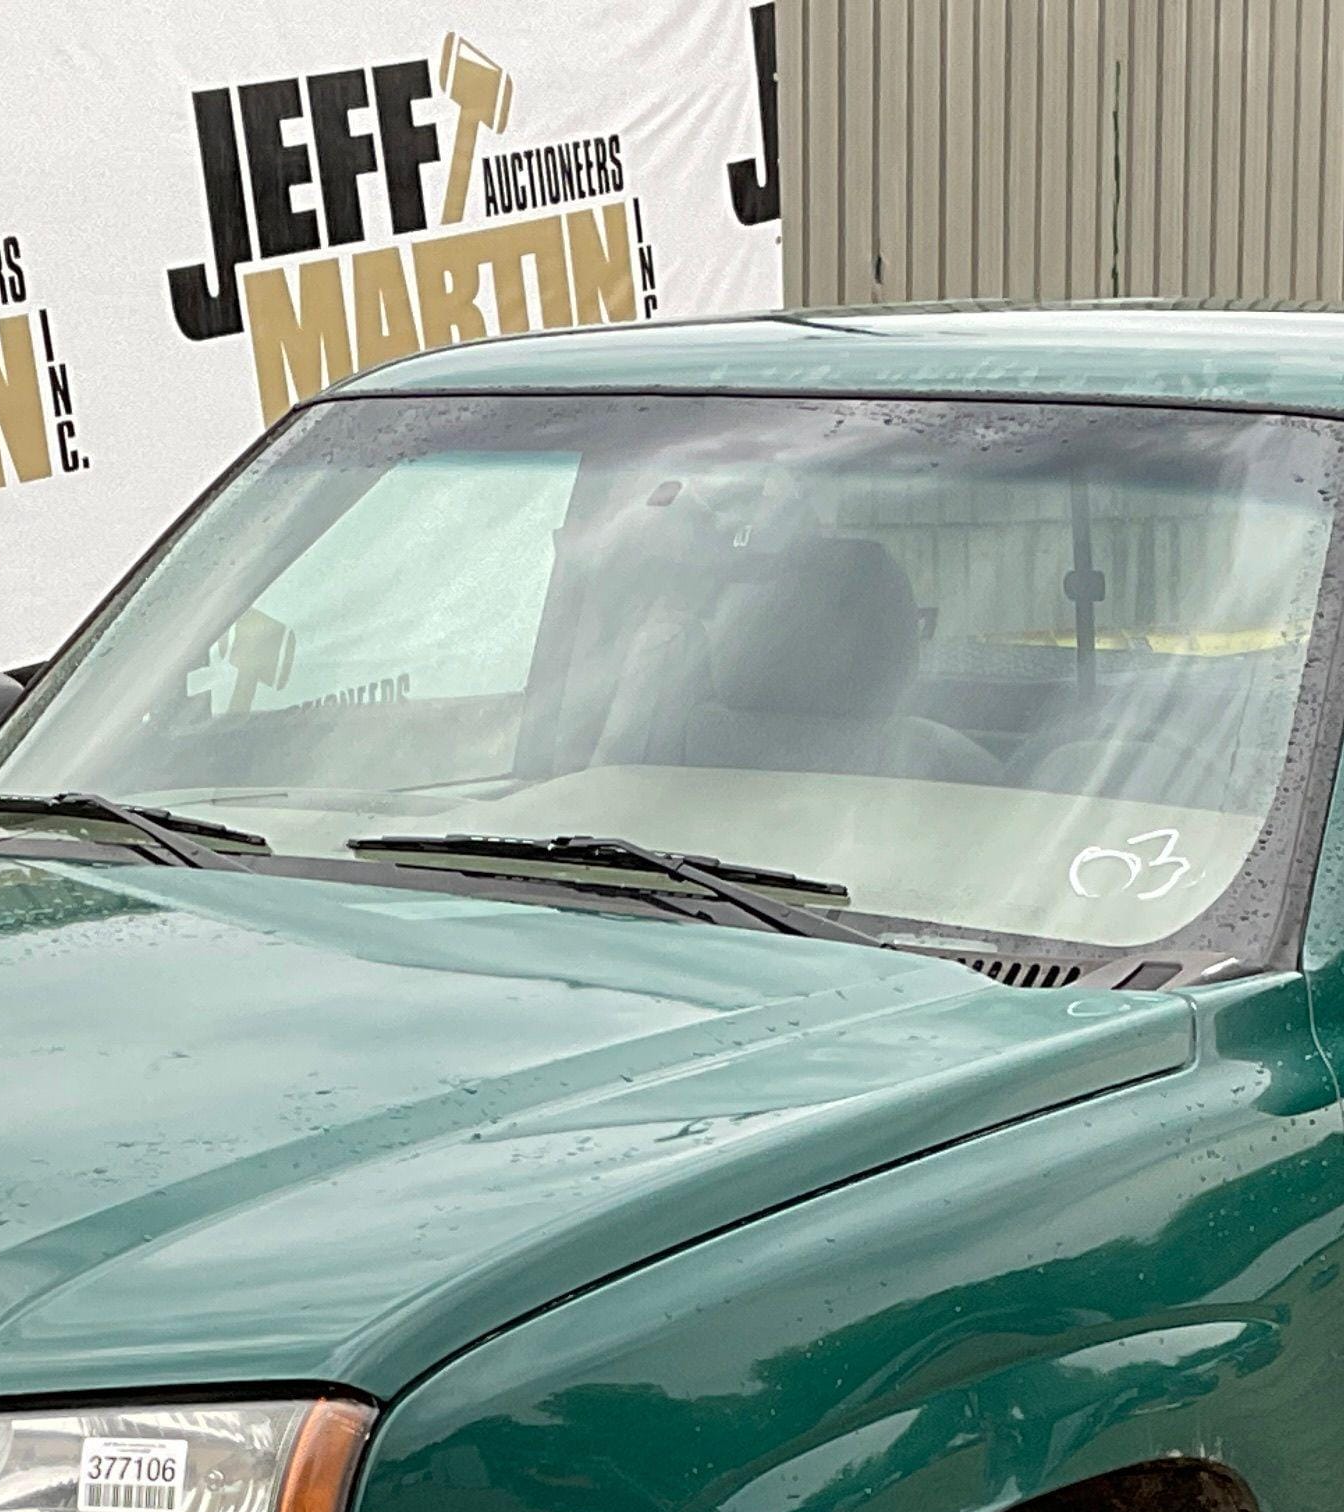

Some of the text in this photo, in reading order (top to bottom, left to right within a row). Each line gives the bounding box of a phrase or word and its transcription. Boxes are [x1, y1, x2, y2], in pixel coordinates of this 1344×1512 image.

[167, 59, 441, 342] JEFF
[482, 134, 624, 217] AUCTIONEERS
[39, 309, 90, 473] INC.
[243, 201, 637, 430] MARTIN
[88, 1455, 176, 1482] 377106
